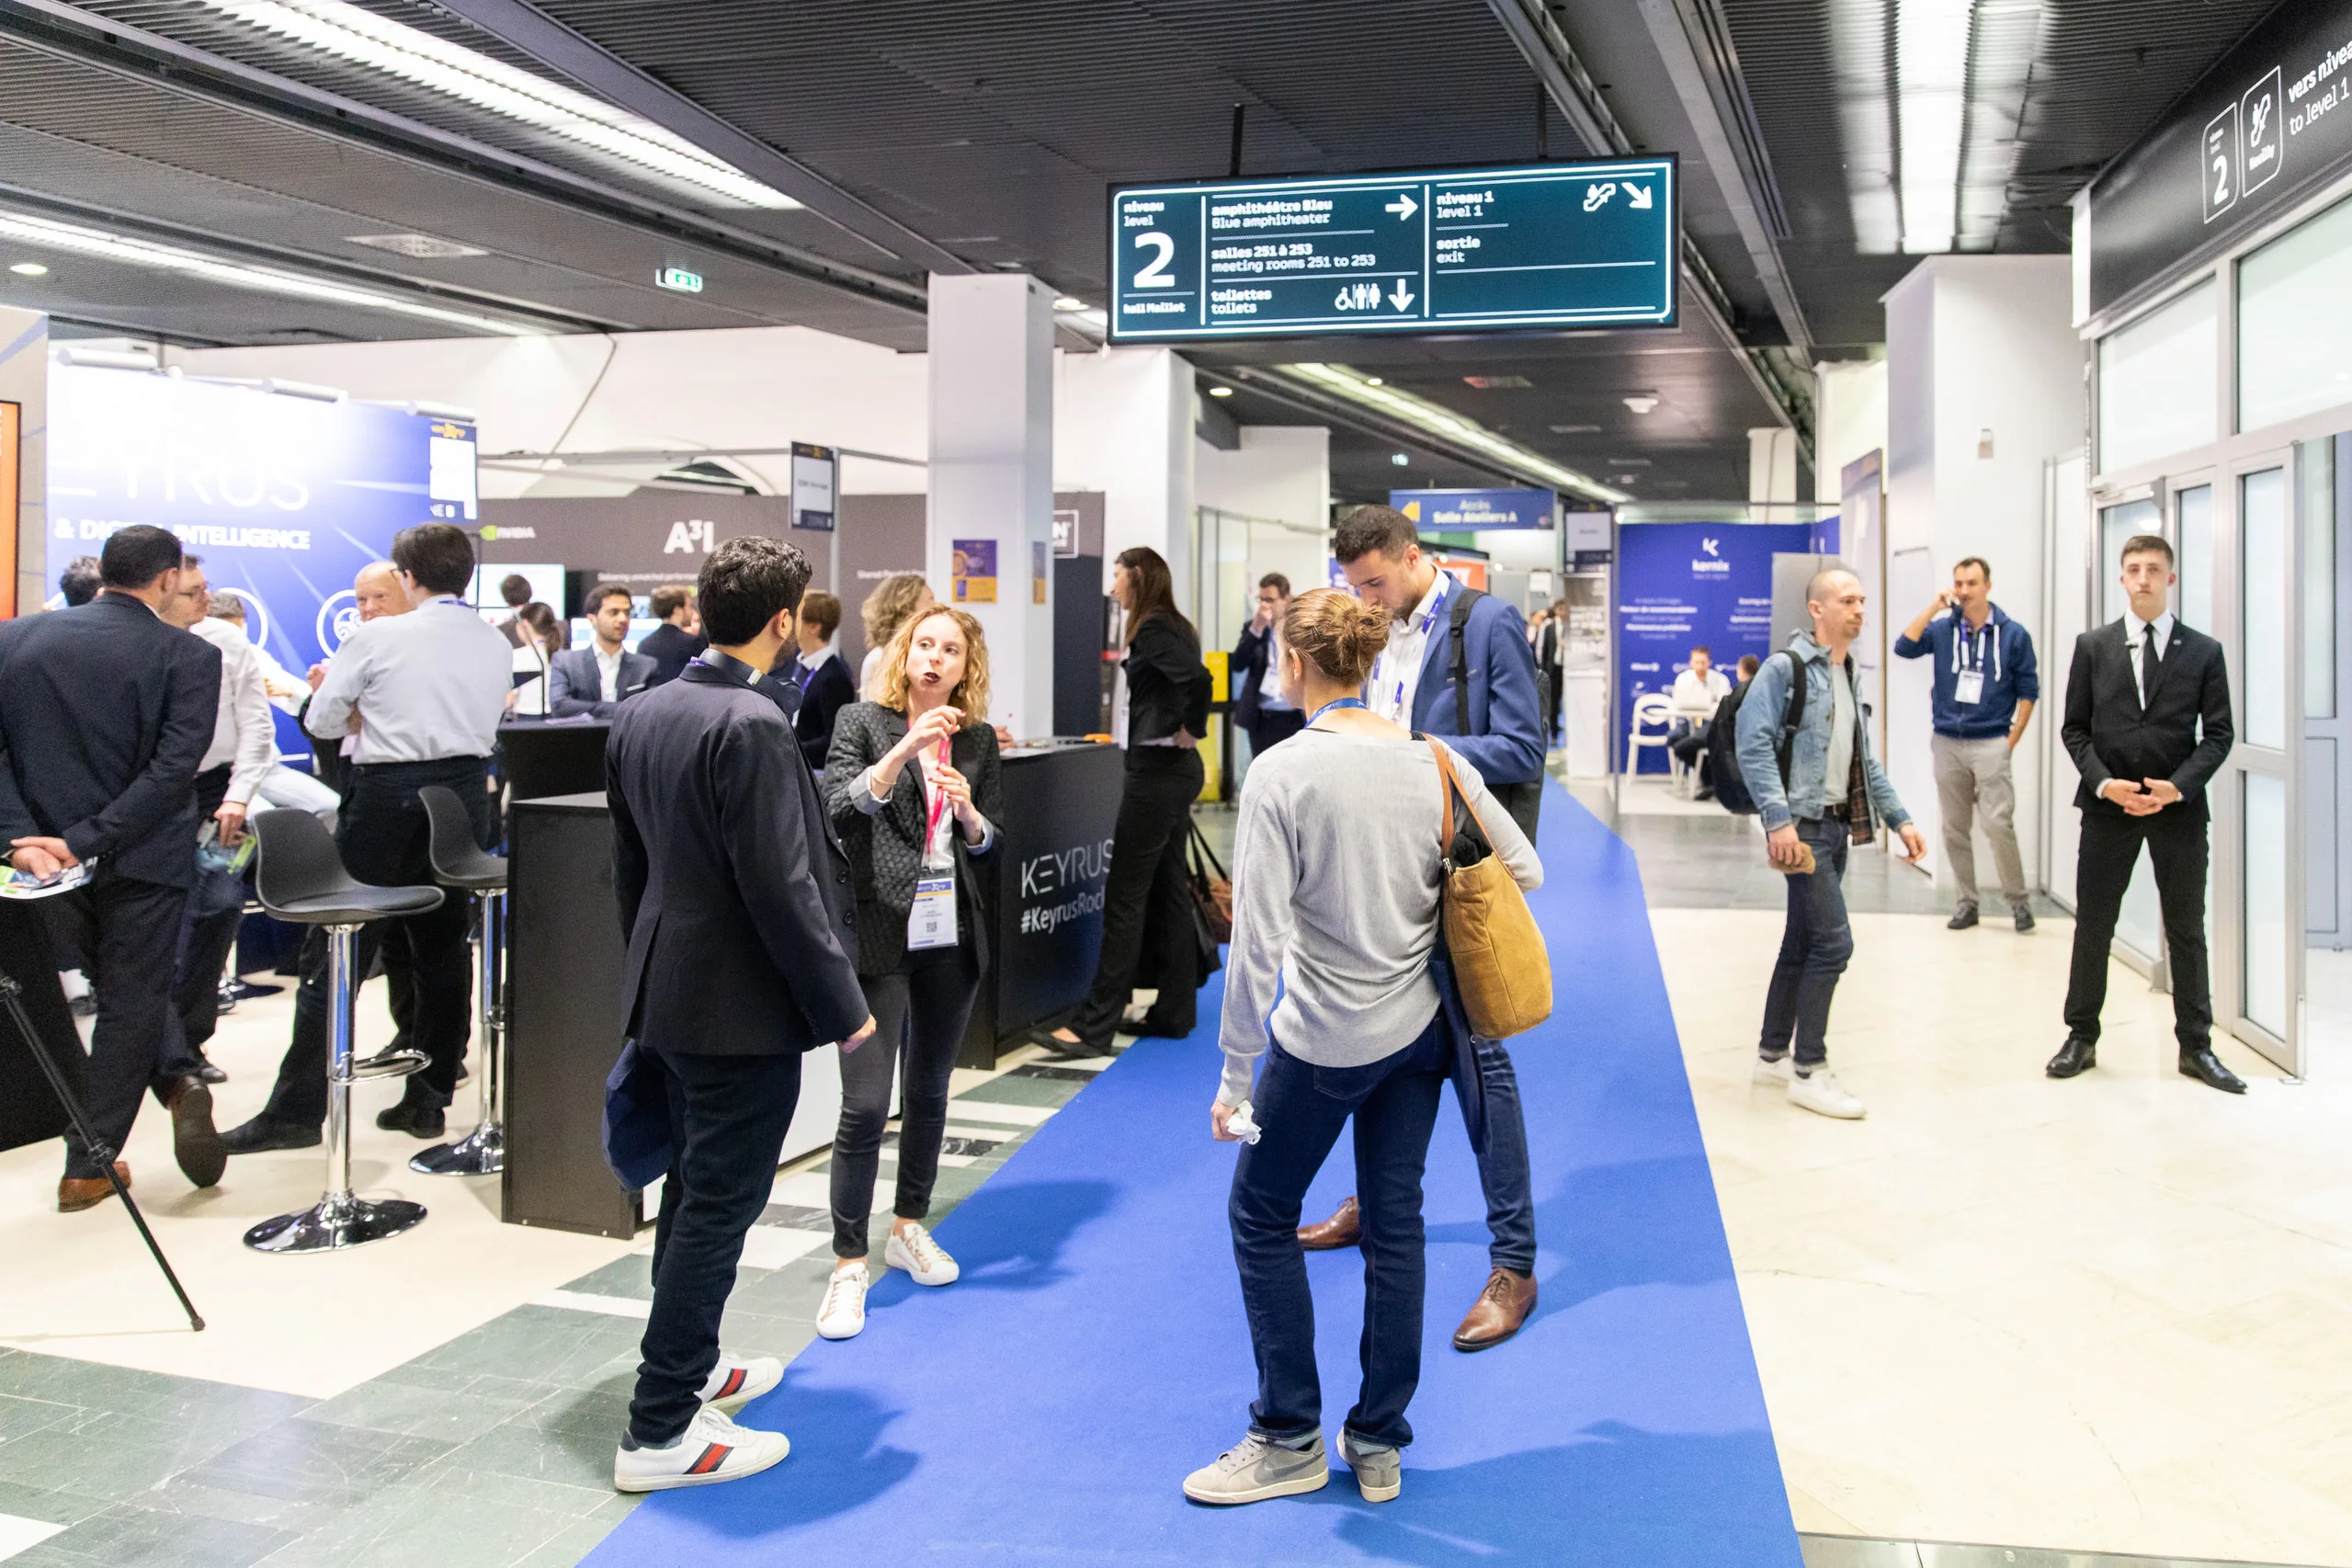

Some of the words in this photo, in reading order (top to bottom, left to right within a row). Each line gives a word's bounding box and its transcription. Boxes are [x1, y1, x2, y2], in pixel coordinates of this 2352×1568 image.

[2289, 70, 2316, 103] vers
[2290, 114, 2304, 135] to
[2305, 85, 2338, 125] level
[2341, 76, 2350, 101] 1
[2213, 155, 2229, 206] 2
[1301, 199, 1333, 211] Bleu
[1437, 191, 1483, 205] niveau
[1484, 190, 1494, 203] 1
[1124, 200, 1165, 213] niveau
[1437, 205, 1471, 219] level
[1473, 204, 1483, 217] 1
[1124, 214, 1154, 227] level
[1211, 217, 1241, 229] Blue
[1243, 212, 1331, 228] amphitheater
[1436, 235, 1482, 250] sortie
[1211, 246, 1253, 259] salles
[1254, 244, 1278, 257] 251
[1289, 243, 1313, 256] 253
[1436, 250, 1465, 264] exit
[1133, 232, 1176, 288] 2
[1211, 259, 1264, 273] meeting
[1266, 257, 1306, 270] rooms
[1307, 256, 1332, 268] 251
[1334, 255, 1349, 267] to
[1351, 254, 1376, 267] 253
[1210, 289, 1272, 301] toilettes
[1210, 301, 1257, 314] toilets
[53, 517, 75, 540] &
[1021, 838, 1115, 899] KEYRUS
